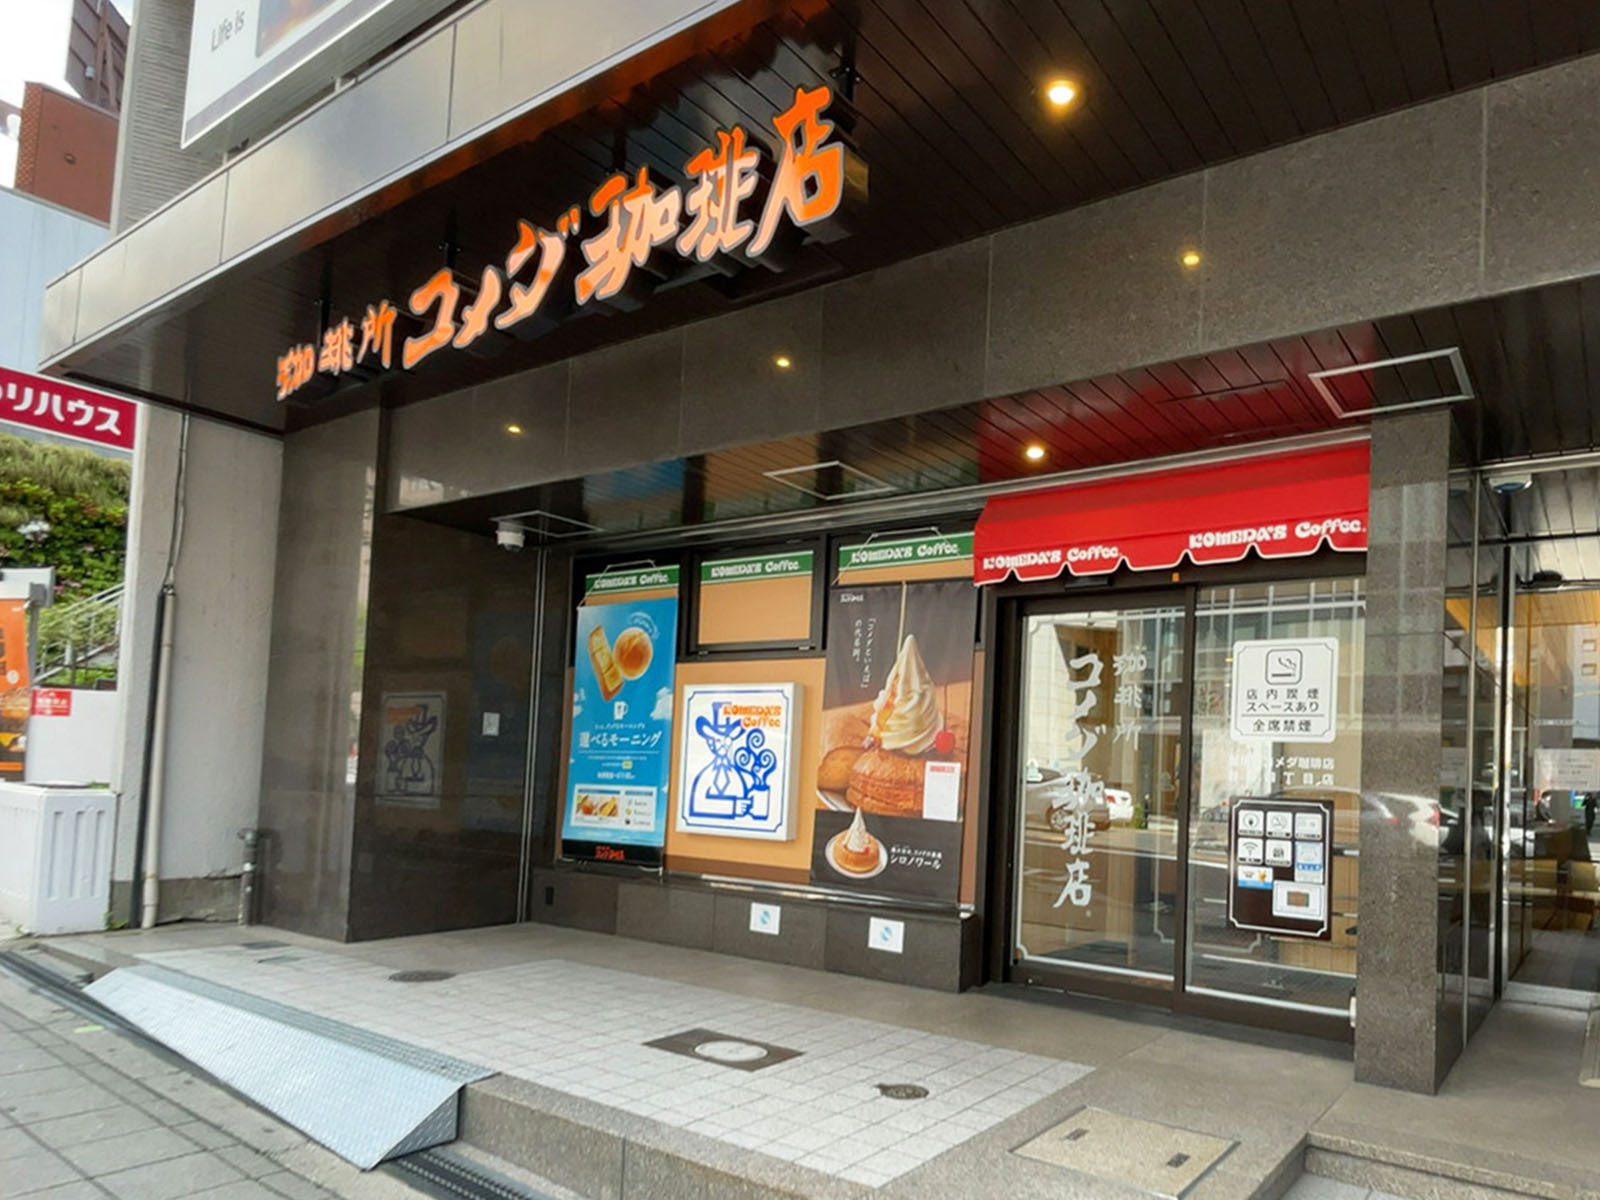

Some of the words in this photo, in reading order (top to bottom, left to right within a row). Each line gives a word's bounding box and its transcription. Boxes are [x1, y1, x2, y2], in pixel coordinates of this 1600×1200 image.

[0, 382, 122, 436] リハウス
[764, 559, 799, 573] Coffee
[1246, 701, 1320, 713] スペースあり
[1253, 719, 1312, 733] 全席禁煙
